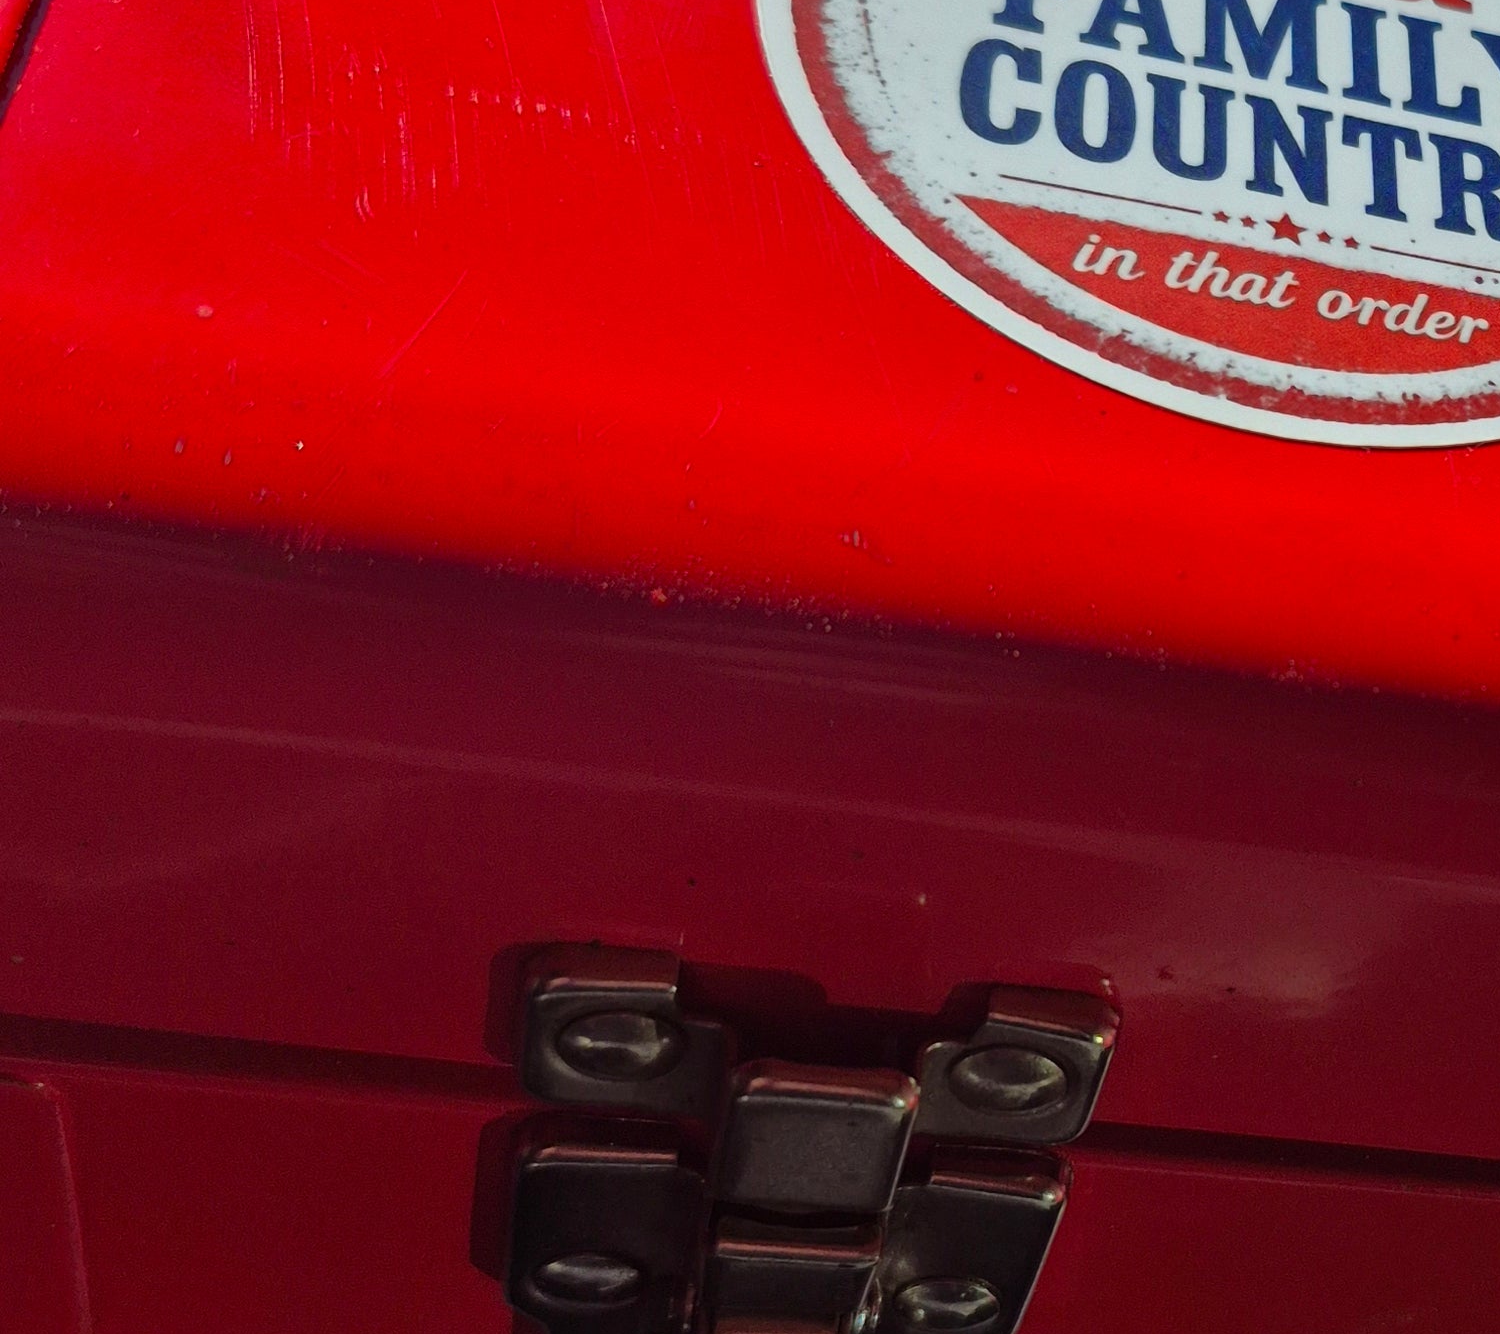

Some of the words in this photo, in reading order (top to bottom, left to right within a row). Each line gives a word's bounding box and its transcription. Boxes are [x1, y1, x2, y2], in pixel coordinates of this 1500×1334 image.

[1072, 235, 1145, 278] in
[1163, 249, 1300, 310] that
[1316, 287, 1491, 346] order
